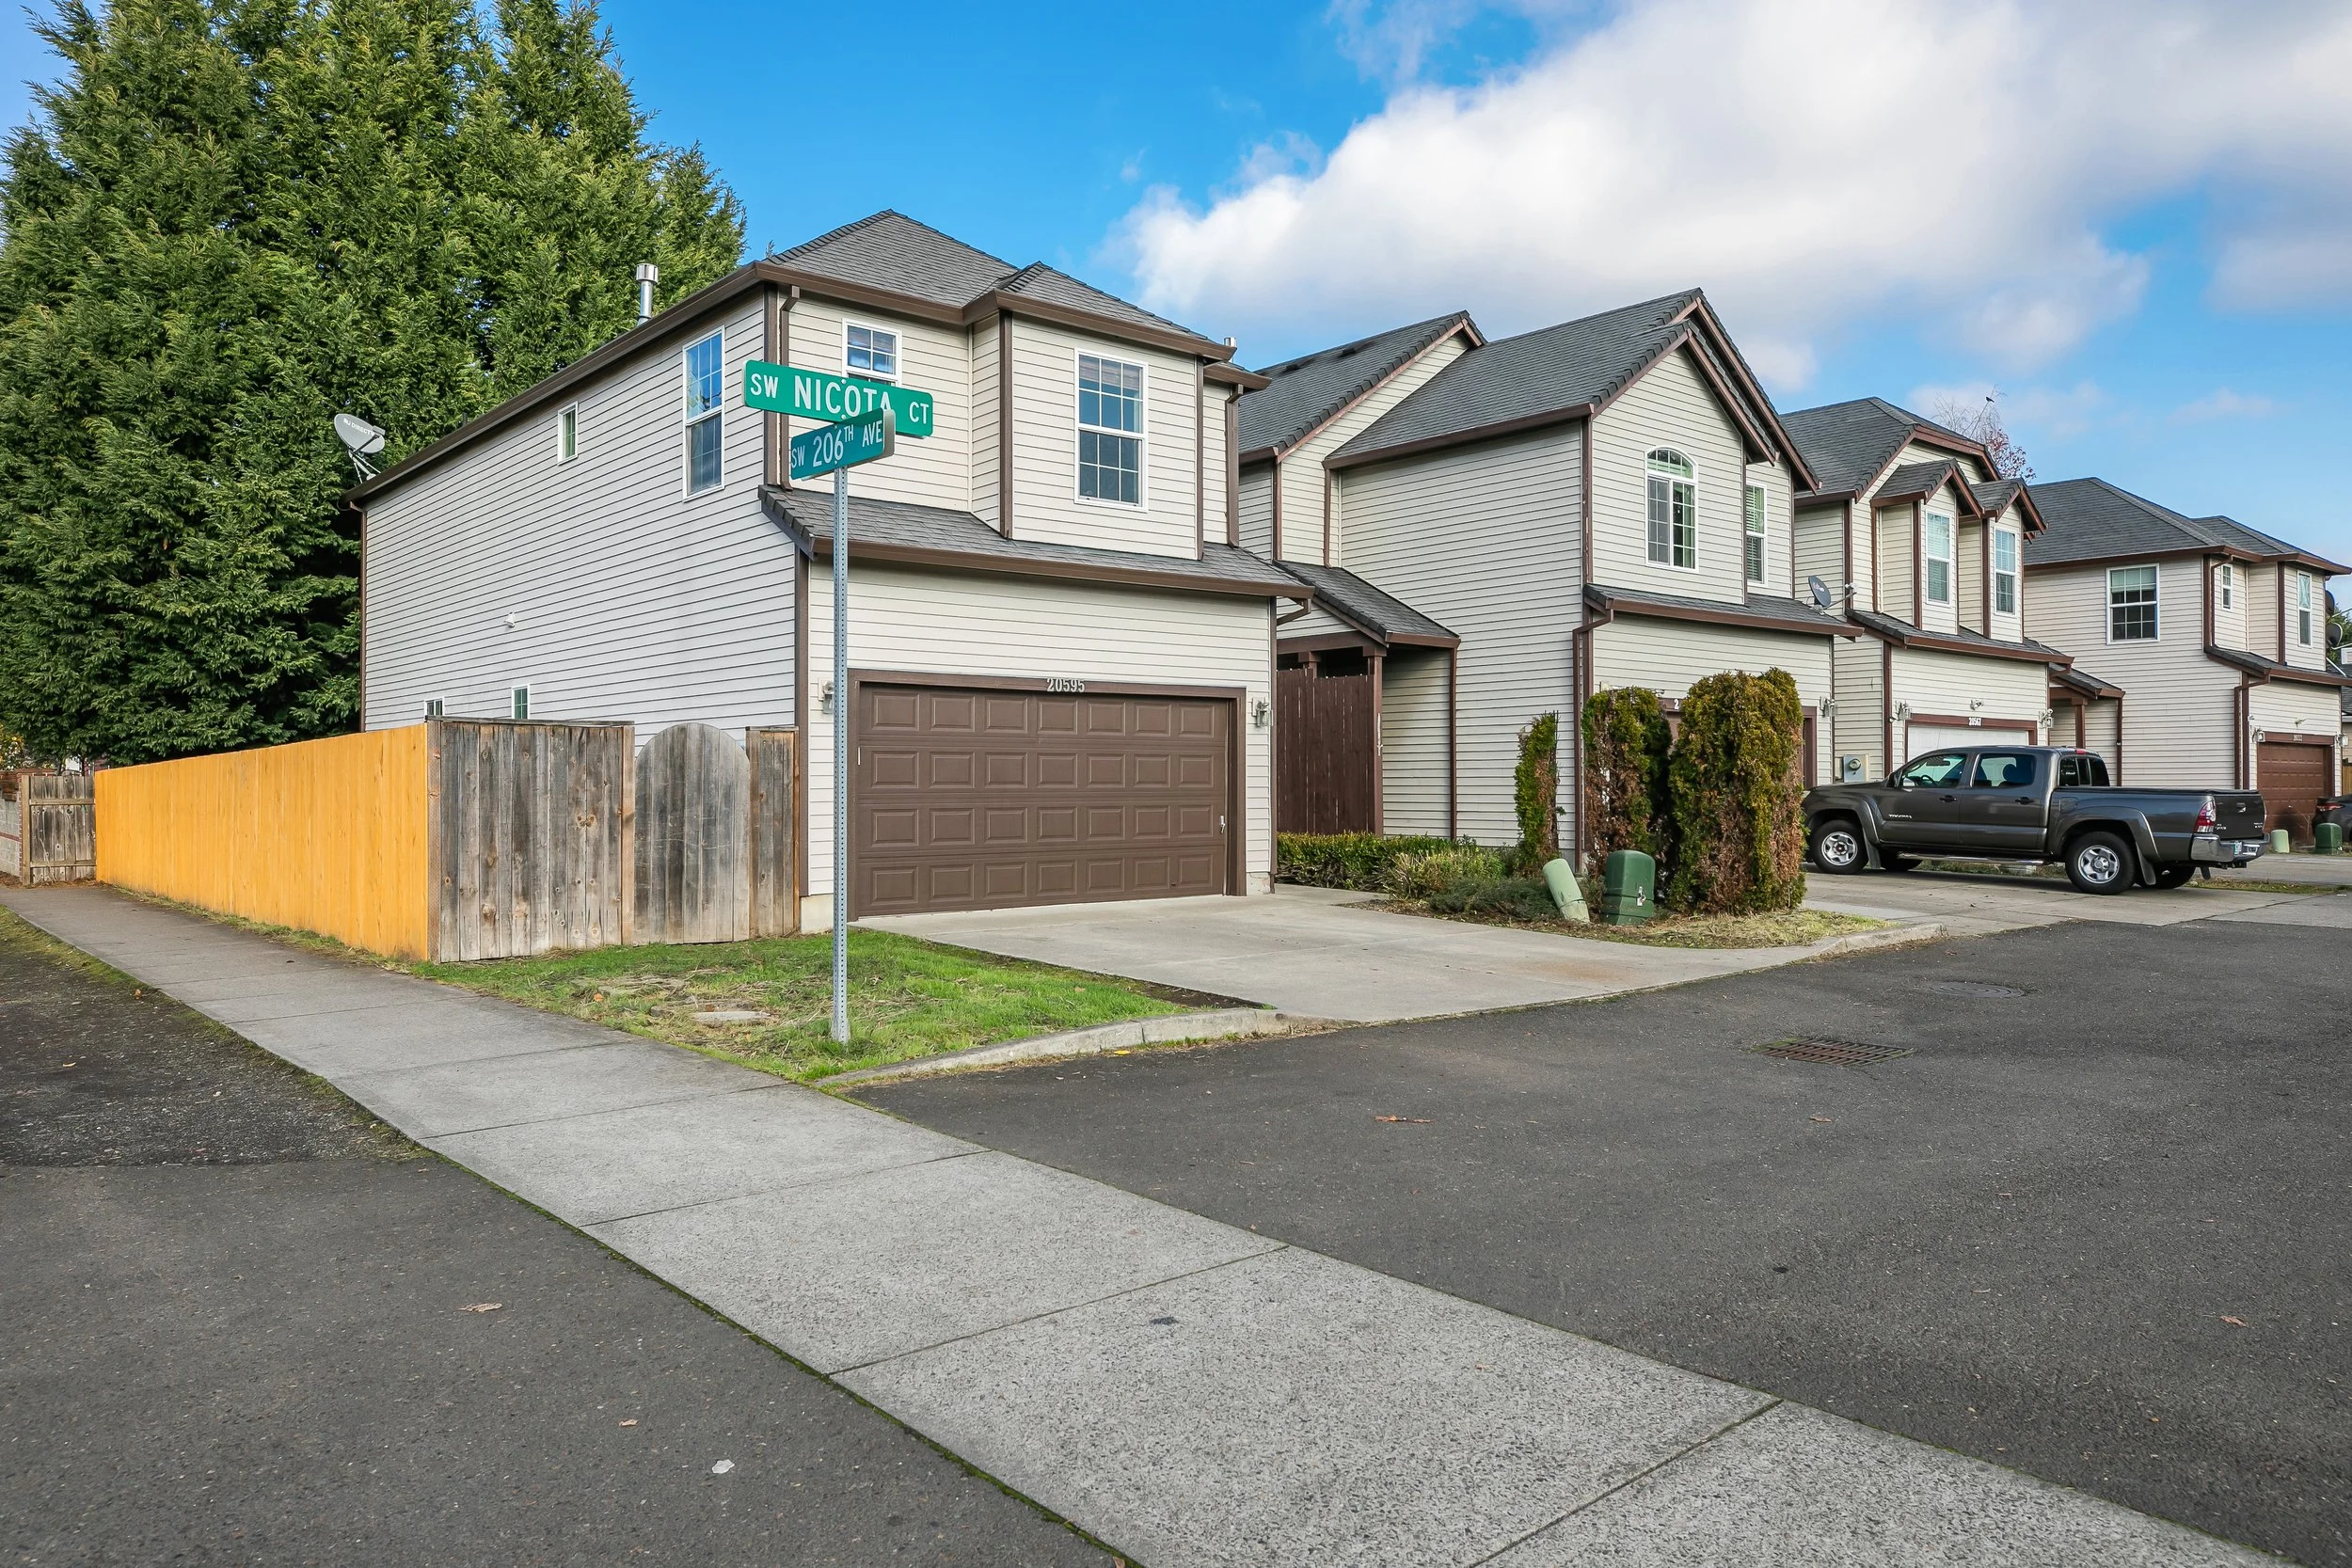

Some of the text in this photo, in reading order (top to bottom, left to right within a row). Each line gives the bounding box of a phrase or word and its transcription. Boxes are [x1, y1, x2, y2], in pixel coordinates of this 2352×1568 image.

[750, 372, 930, 424] SW NICOTA CT
[791, 445, 805, 468] SW
[862, 420, 882, 448] AVE
[1046, 677, 1085, 693] 20595
